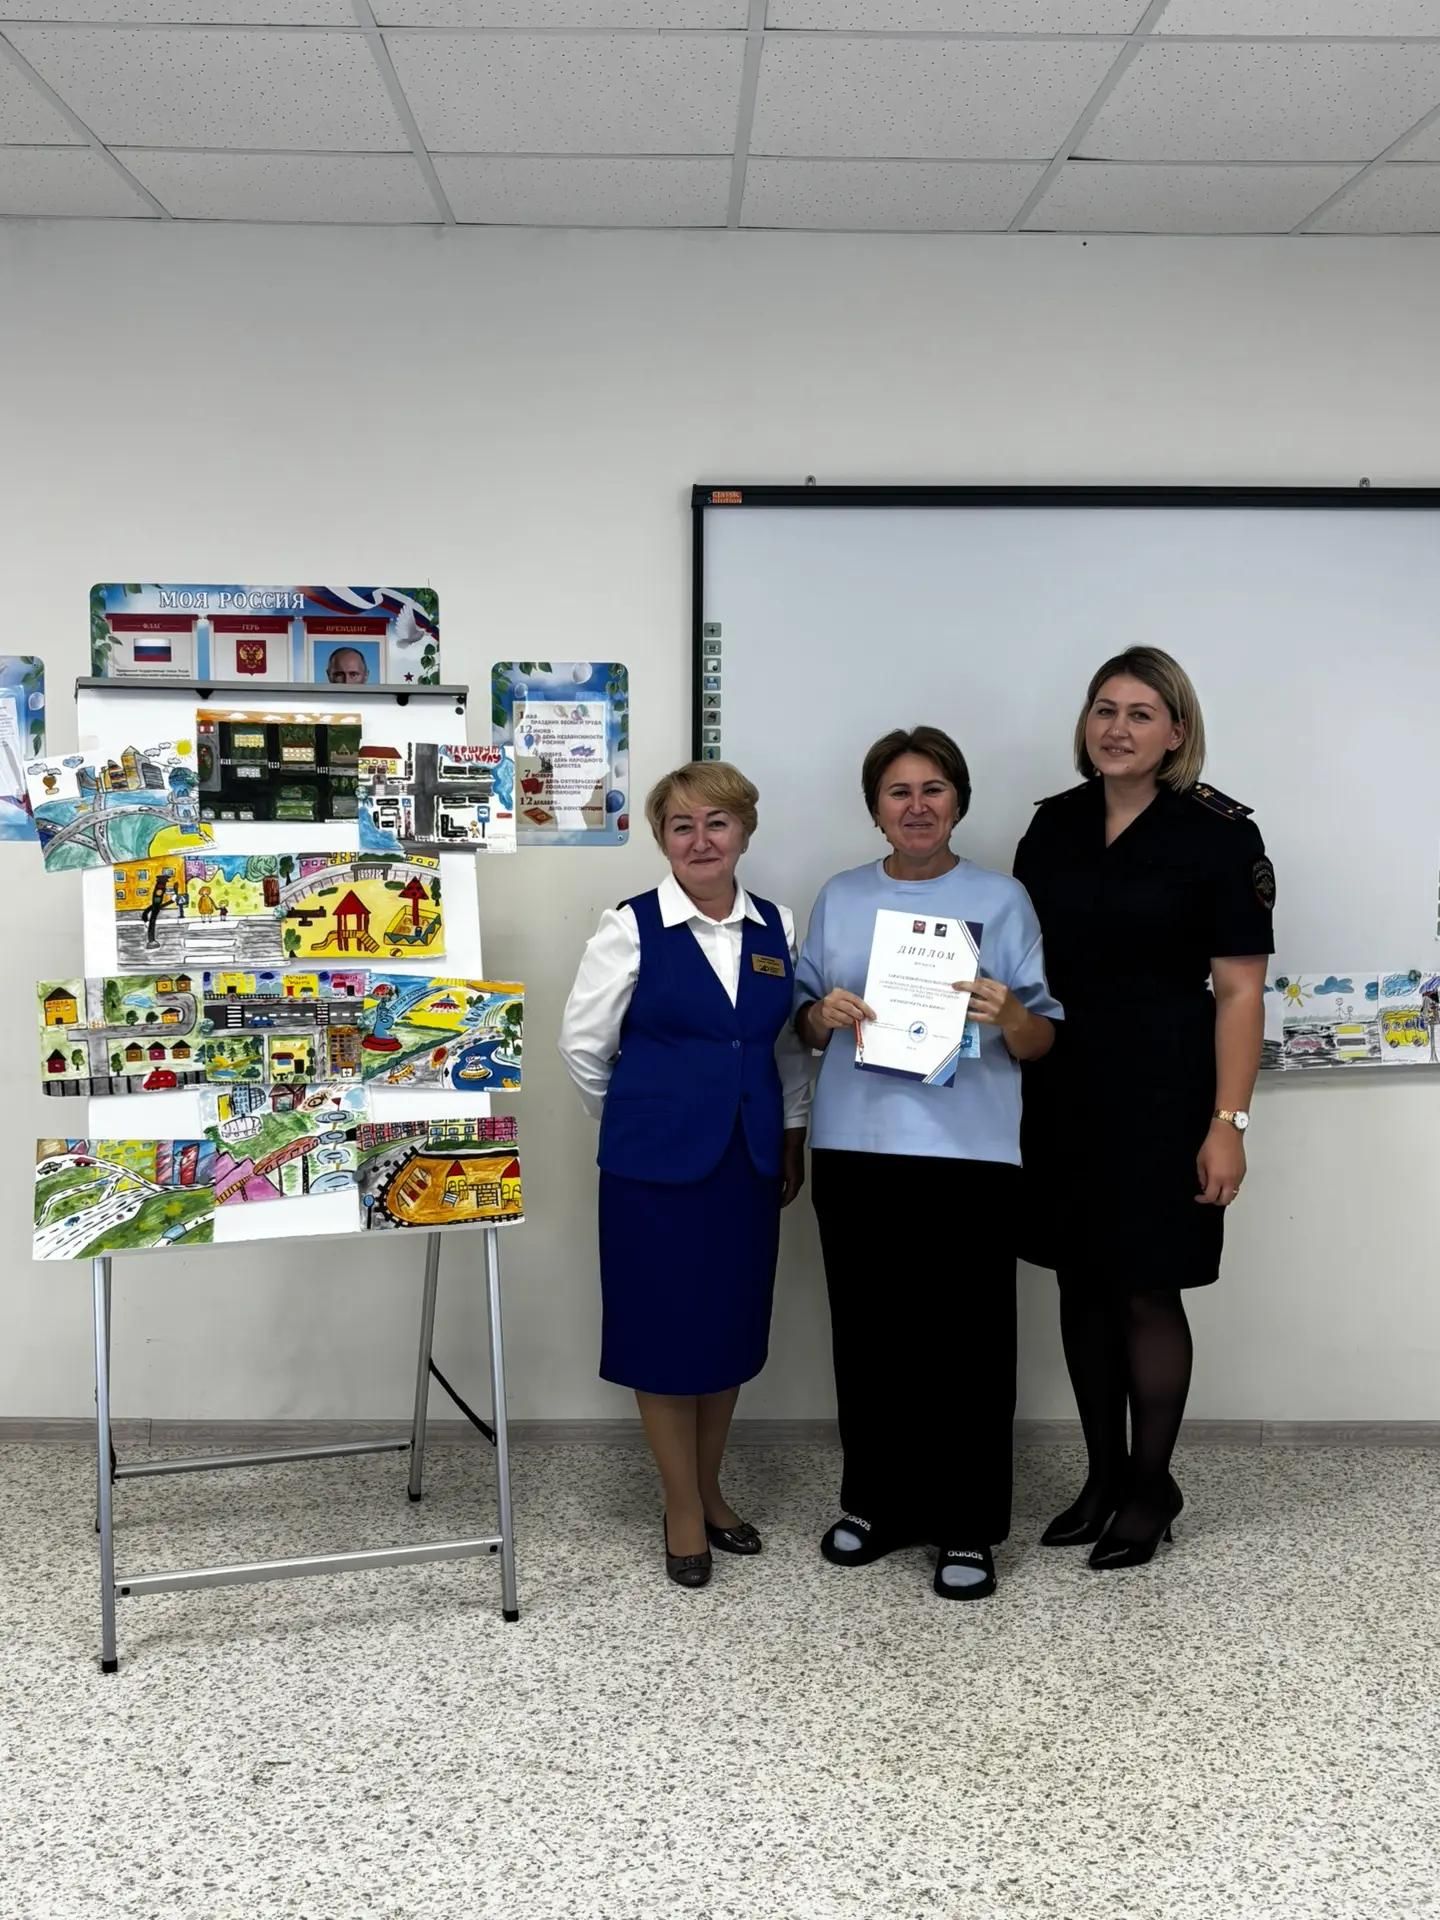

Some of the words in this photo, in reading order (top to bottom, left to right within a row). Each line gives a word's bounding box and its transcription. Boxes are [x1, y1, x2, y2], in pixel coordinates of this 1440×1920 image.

[159, 591, 208, 608] МОЯ
[218, 592, 305, 609] РОССИЯ
[520, 725, 533, 734] 12
[520, 797, 533, 805] 12
[897, 945, 955, 960] ДИПЛОМ
